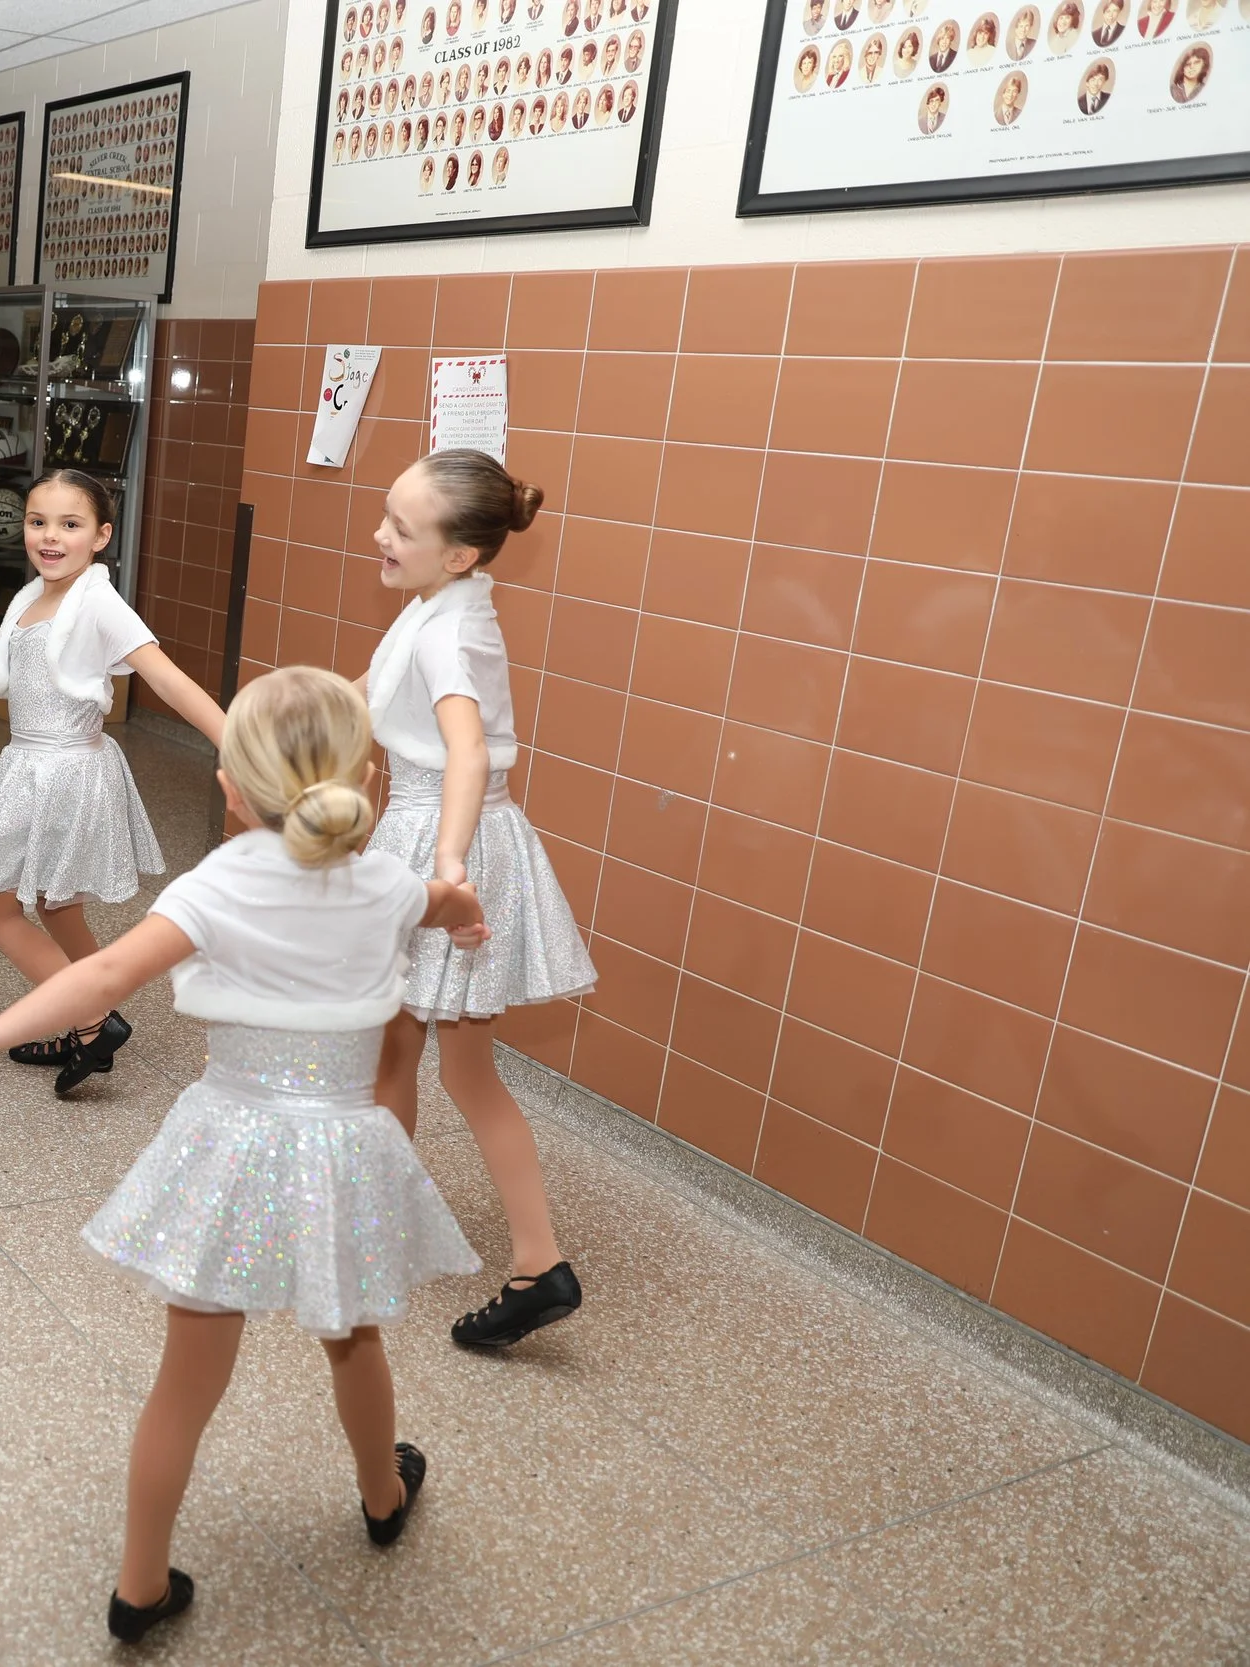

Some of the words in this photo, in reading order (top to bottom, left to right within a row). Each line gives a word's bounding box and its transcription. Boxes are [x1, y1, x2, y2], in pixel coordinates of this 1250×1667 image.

[435, 46, 471, 64] CLASS
[474, 41, 490, 56] OF
[492, 34, 521, 52] 1982
